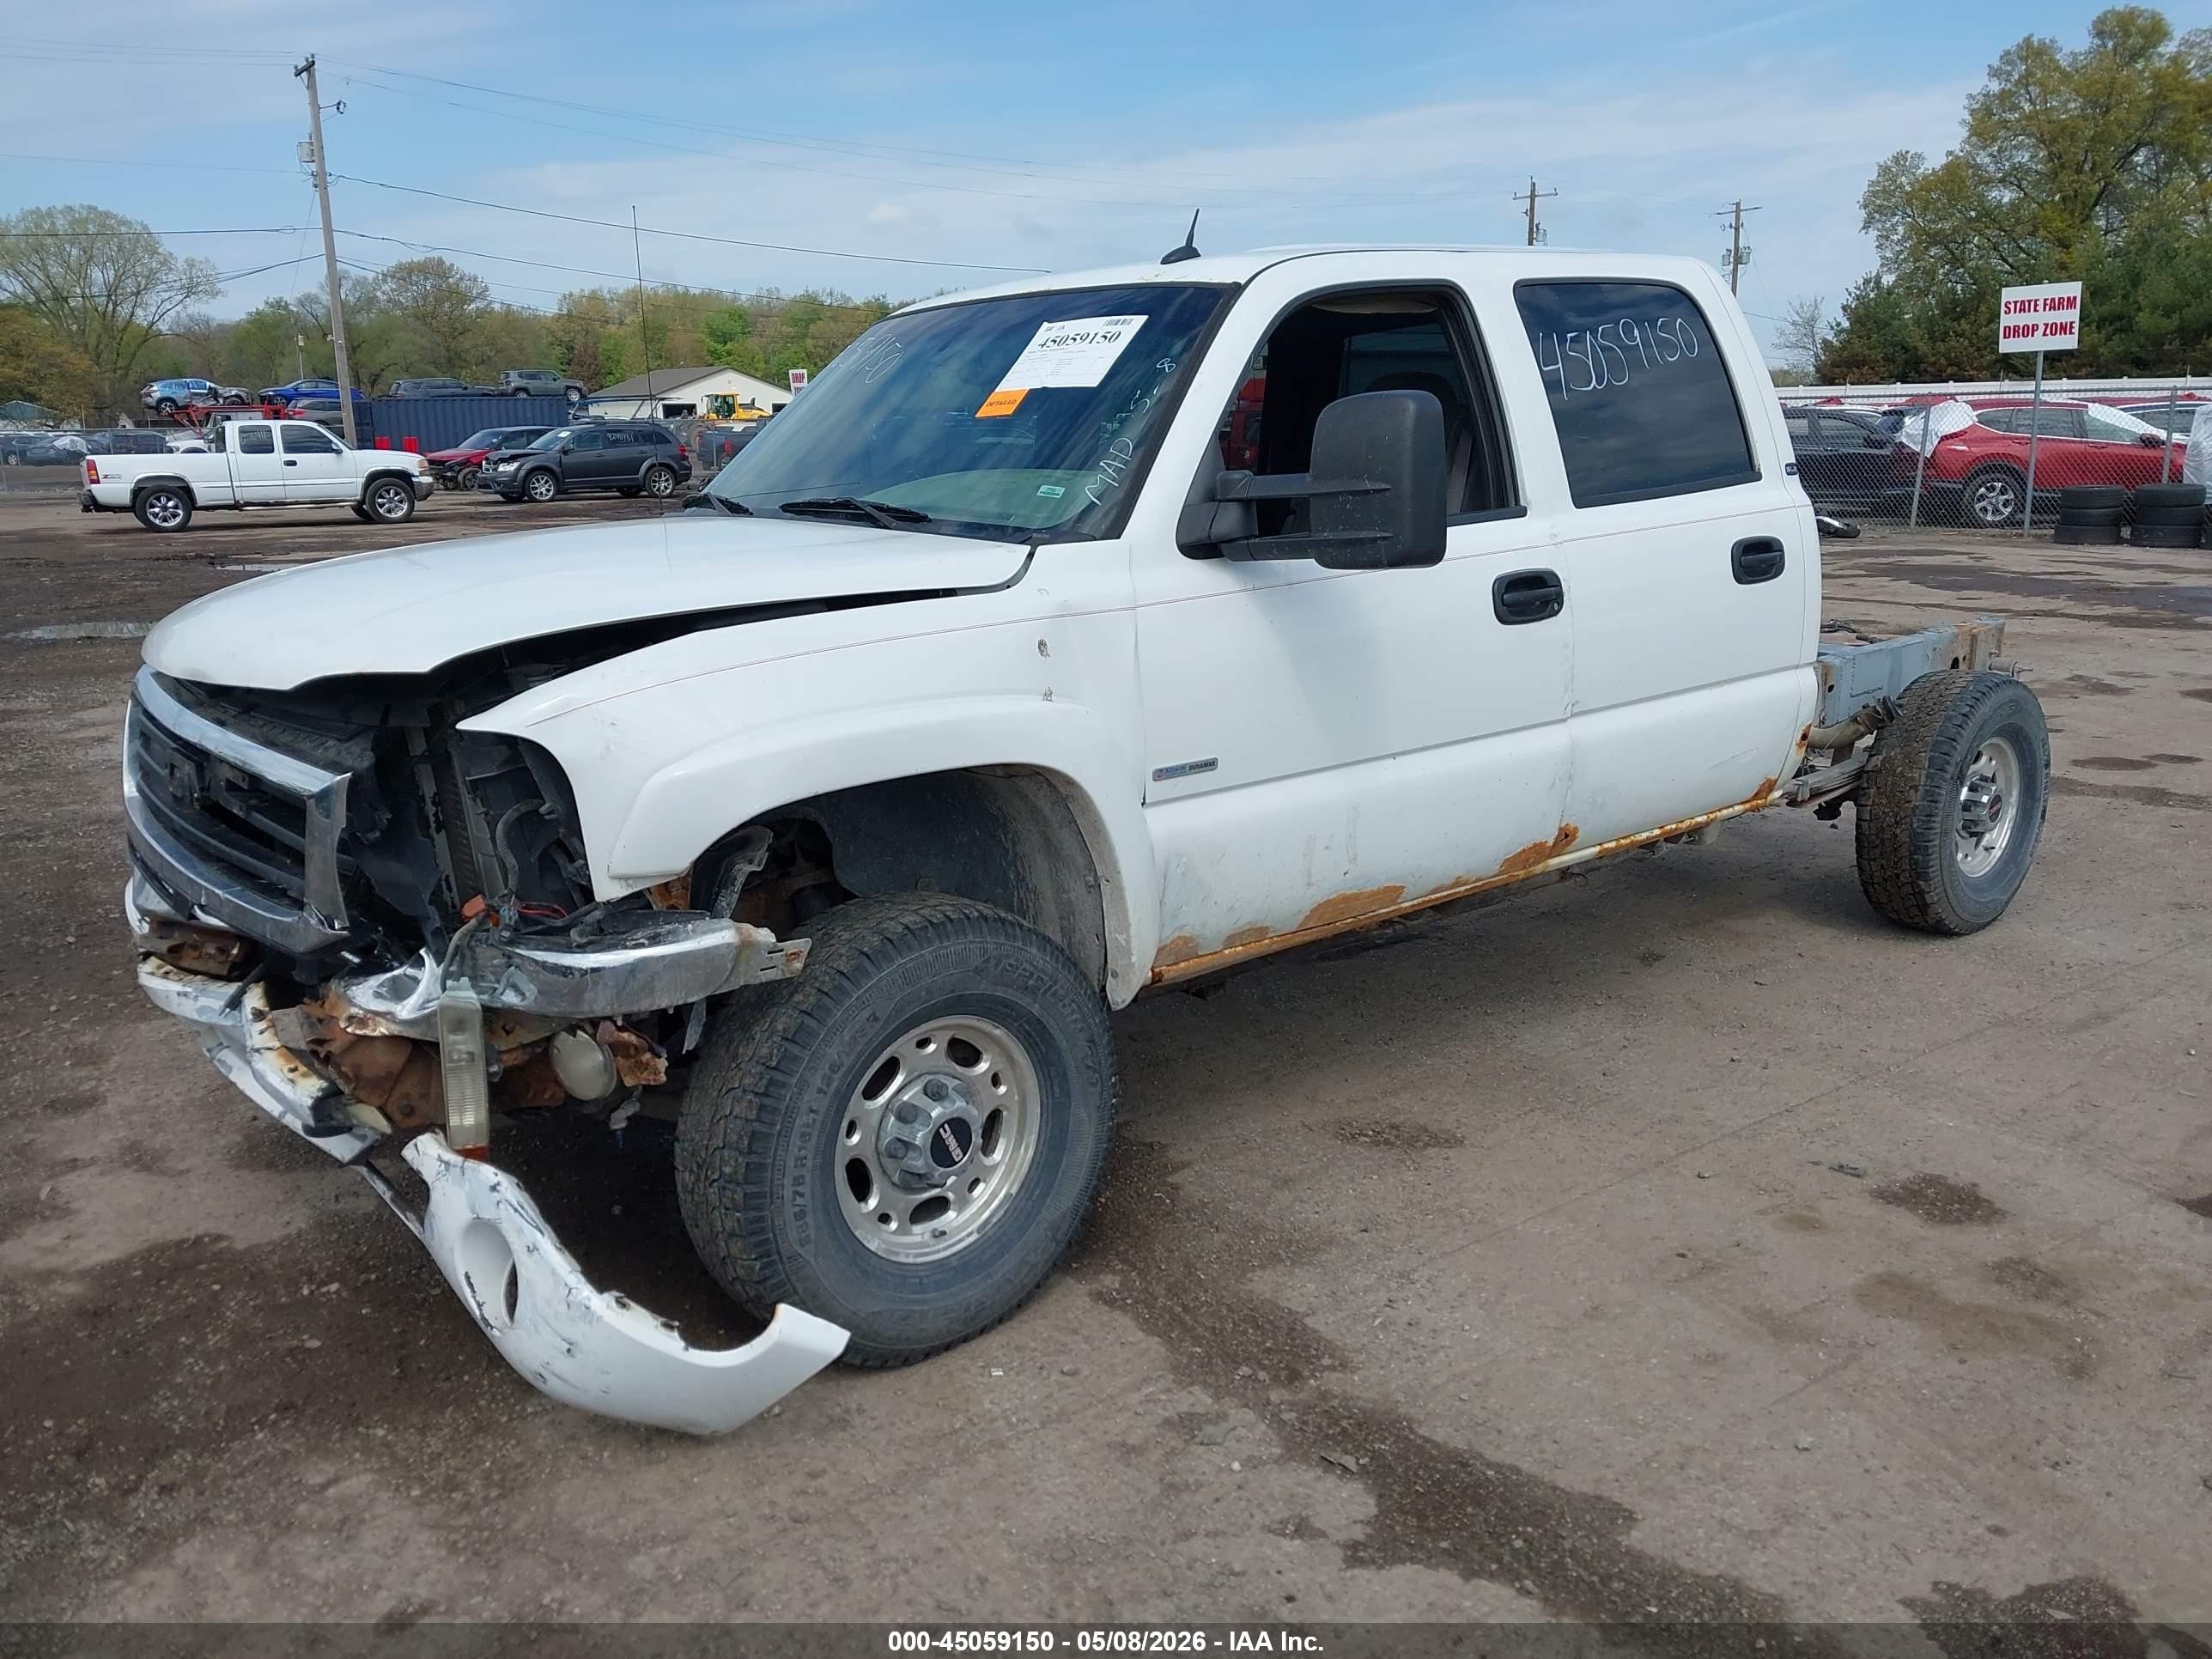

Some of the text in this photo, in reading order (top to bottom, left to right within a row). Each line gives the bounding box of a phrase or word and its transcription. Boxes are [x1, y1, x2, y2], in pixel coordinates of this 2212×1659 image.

[2003, 295, 2077, 315] STATE FARM
[1038, 329, 1121, 349] 45059150
[2002, 320, 2075, 339] DROP ZONE
[1540, 318, 1698, 400] 45059150
[791, 372, 805, 384] DROP
[986, 398, 1018, 407] DETAILED
[1085, 437, 1133, 506] MAD
[939, 1122, 963, 1162] GMC
